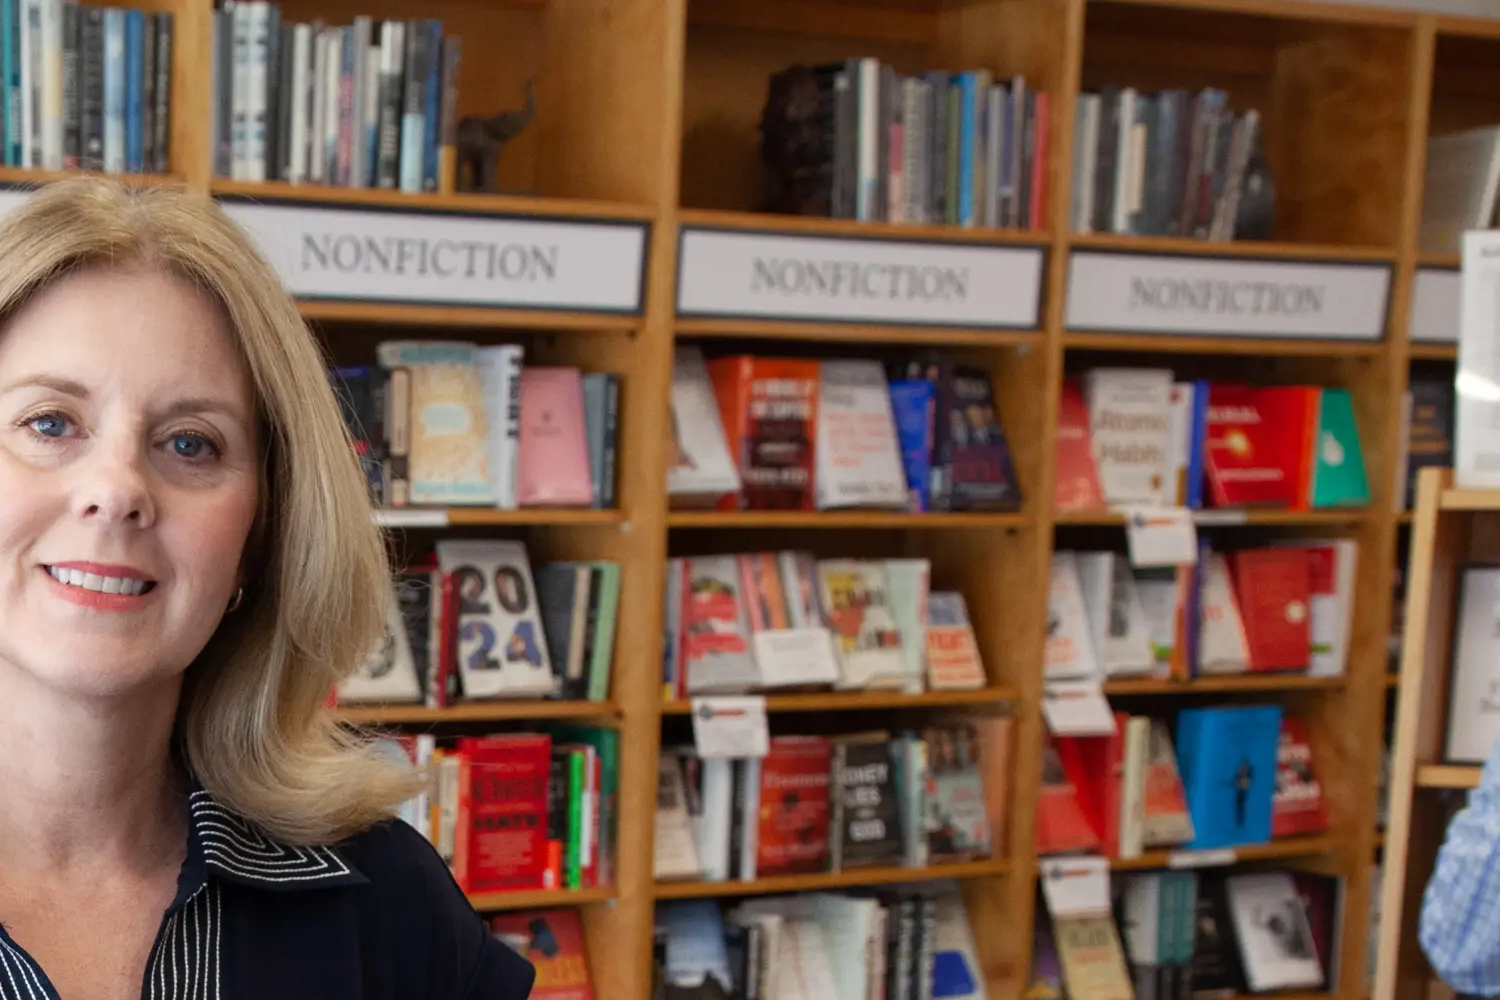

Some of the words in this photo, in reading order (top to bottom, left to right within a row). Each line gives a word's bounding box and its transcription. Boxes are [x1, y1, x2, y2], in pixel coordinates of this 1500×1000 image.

[300, 232, 560, 282] NONFICTION
[750, 256, 971, 302] NONFICTION
[1130, 275, 1327, 317] NONFICTION
